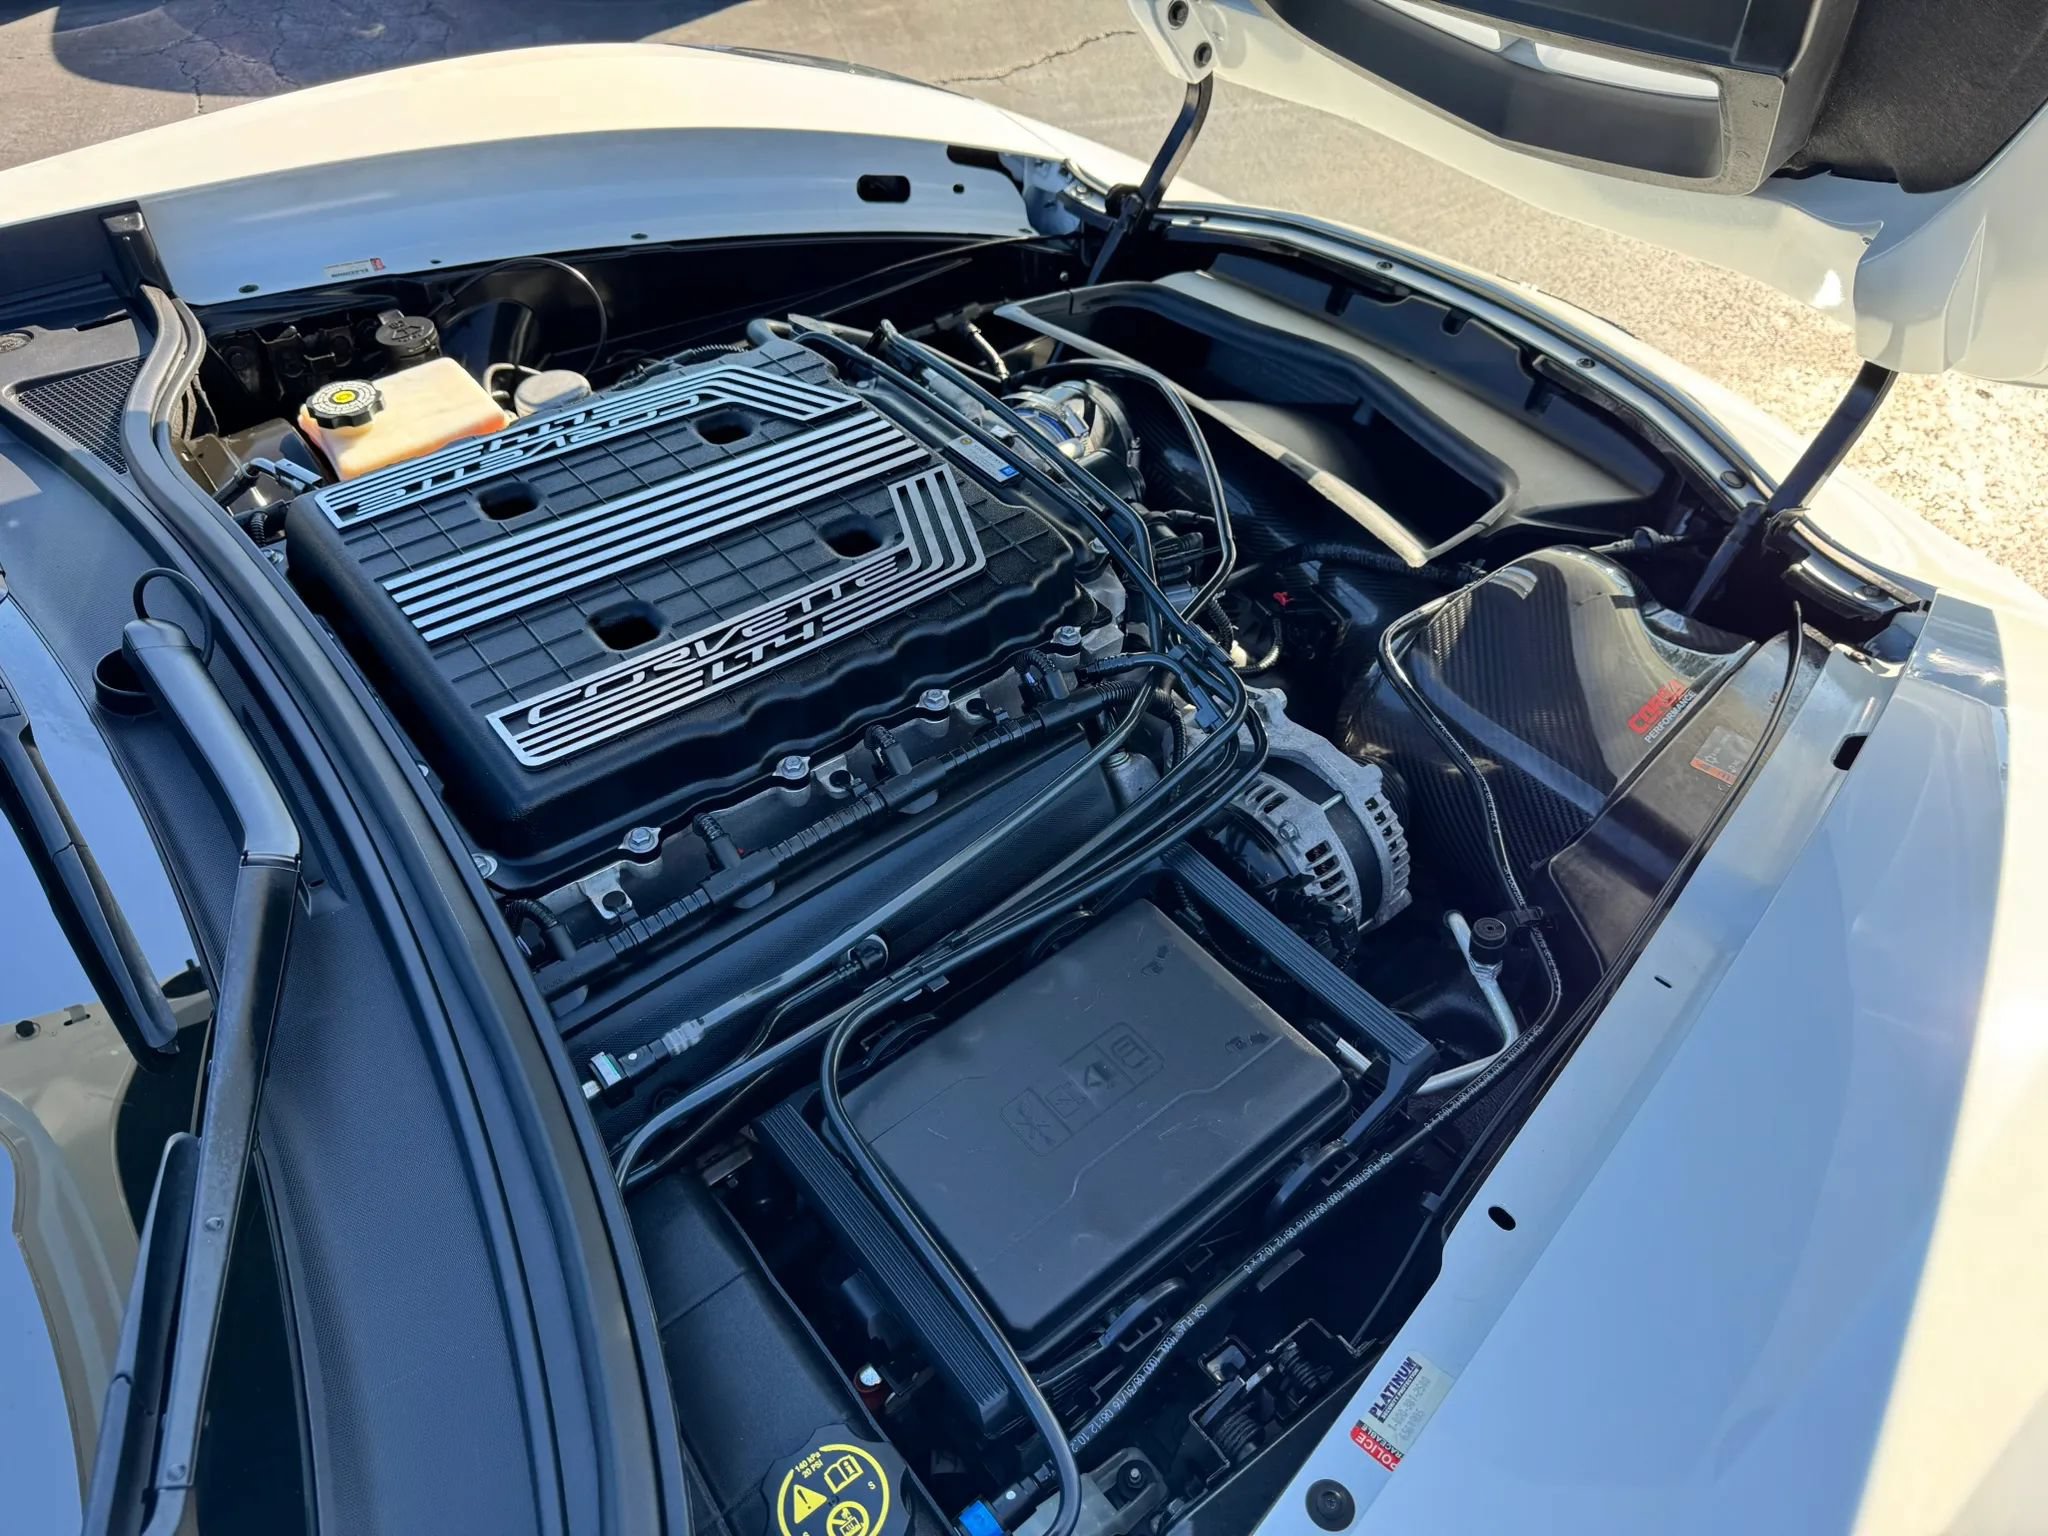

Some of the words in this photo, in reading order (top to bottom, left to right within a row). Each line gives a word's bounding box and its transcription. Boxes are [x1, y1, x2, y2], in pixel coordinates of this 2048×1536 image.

[490, 413, 587, 453] LT4
[356, 394, 699, 517] CORVETTE
[528, 557, 898, 726] CORVETTE
[712, 621, 814, 684] LT4
[1628, 679, 1688, 735] CORSA
[1644, 690, 1696, 743] PERFORMANCE
[1255, 1243, 1276, 1262] 10.2
[1190, 1302, 1208, 1319] CSA
[1142, 1355, 1161, 1375] 1000
[1111, 1372, 1146, 1411] 08/31/16
[1368, 1356, 1417, 1418] PLATINUM
[1087, 1407, 1114, 1434] 08:12
[1067, 1430, 1091, 1453] 10.2
[1354, 1431, 1397, 1470] POLICE
[794, 1459, 809, 1472] 140
[800, 1467, 813, 1478] 20
[809, 1459, 823, 1471] PSI
